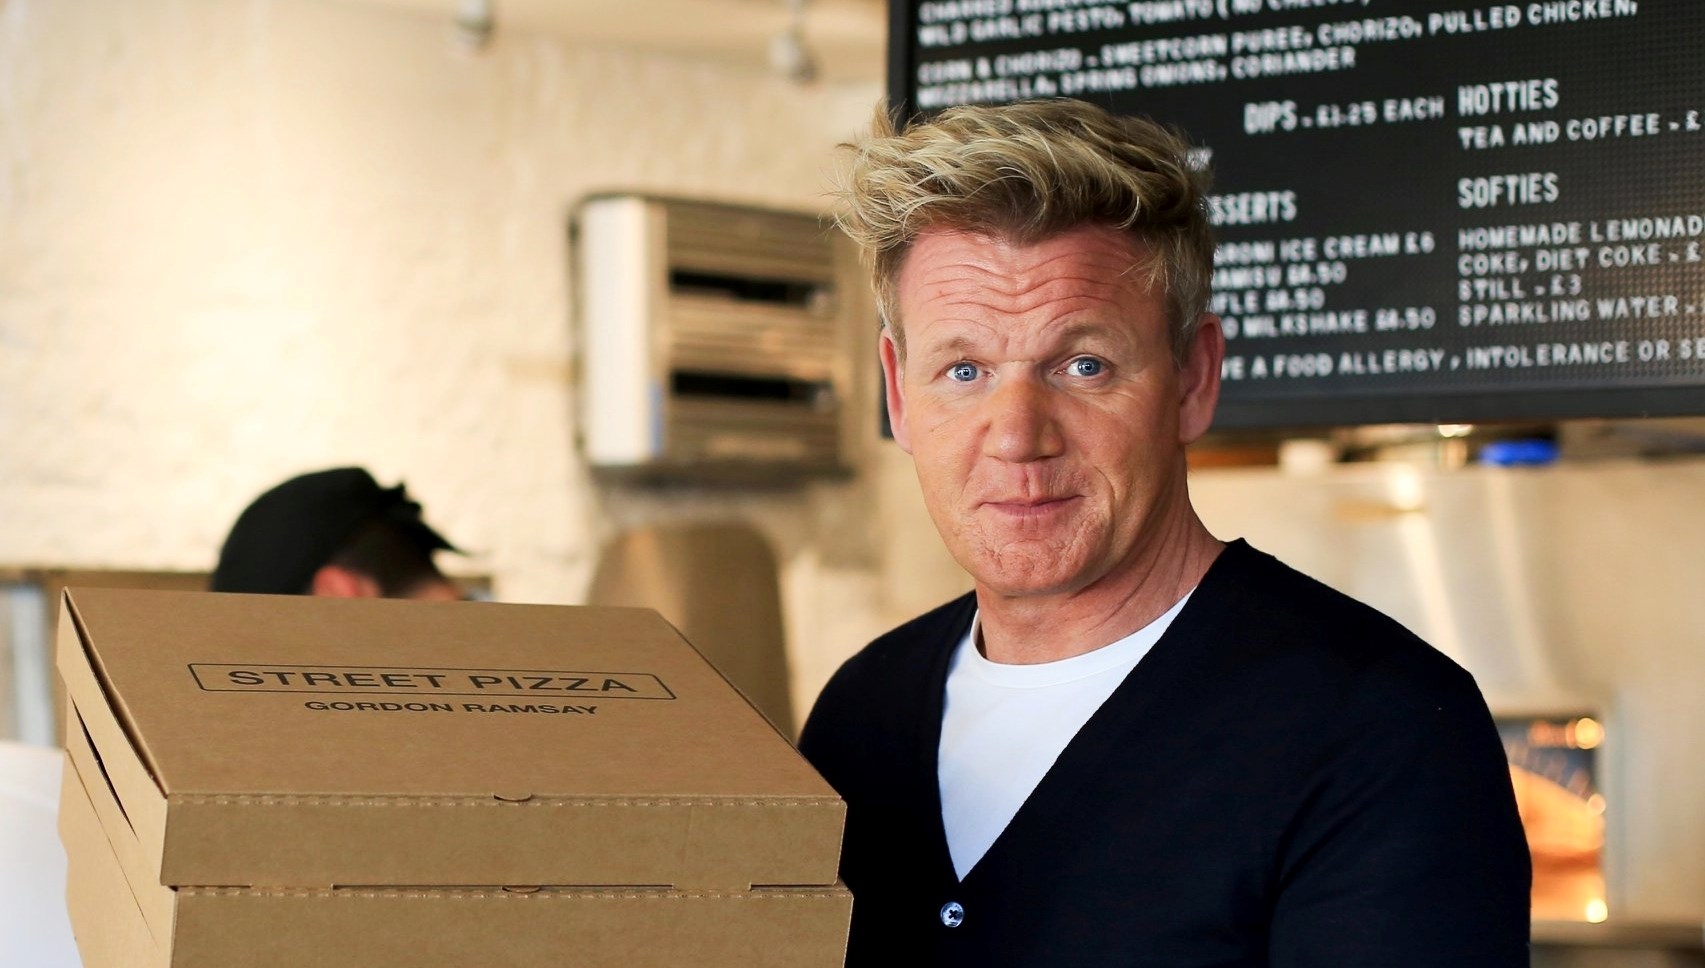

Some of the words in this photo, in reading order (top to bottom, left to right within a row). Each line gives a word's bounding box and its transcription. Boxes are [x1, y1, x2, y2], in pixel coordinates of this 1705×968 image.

[1101, 34, 1228, 67] SWEETCORN
[1231, 25, 1313, 53] PUREE,
[1317, 16, 1422, 46] CHORIZO,
[1428, 5, 1522, 35] PULLED
[1527, 0, 1638, 26] CHICKEN,
[1060, 65, 1137, 95] SPRING
[1230, 46, 1356, 79] CORIANDER
[1458, 78, 1559, 116] HOTTIES
[1244, 100, 1298, 134] DIPS
[1383, 96, 1444, 123] EACH
[1458, 125, 1504, 149] TEA
[1512, 120, 1559, 146] AND
[1566, 113, 1660, 140] COFFEE
[1458, 172, 1559, 208] SOFTIES
[1206, 190, 1297, 226] SSERTS
[1280, 237, 1317, 261] ICE
[1323, 232, 1400, 259] CREAM
[1404, 231, 1435, 254] £6
[1458, 222, 1582, 250] HOMEMADE
[1590, 215, 1705, 243] LEMONAD
[1210, 264, 1282, 289] AMISU
[1457, 251, 1529, 276] COKE,
[1535, 247, 1590, 272] DIET
[1598, 243, 1661, 268] COKE
[1458, 277, 1526, 301] STILL
[1242, 309, 1369, 338] MILKSHAKE
[1458, 299, 1590, 327] SPARKLING
[1597, 295, 1679, 320] WATER
[1251, 355, 1268, 379] A
[1273, 352, 1333, 378] FOOD
[1466, 340, 1630, 370] INTOLERANCE
[1638, 337, 1670, 361] OR
[228, 670, 446, 689] STREET
[468, 674, 638, 693] PIZZA
[304, 701, 454, 712] GORDON
[461, 703, 598, 715] RAMSAY
